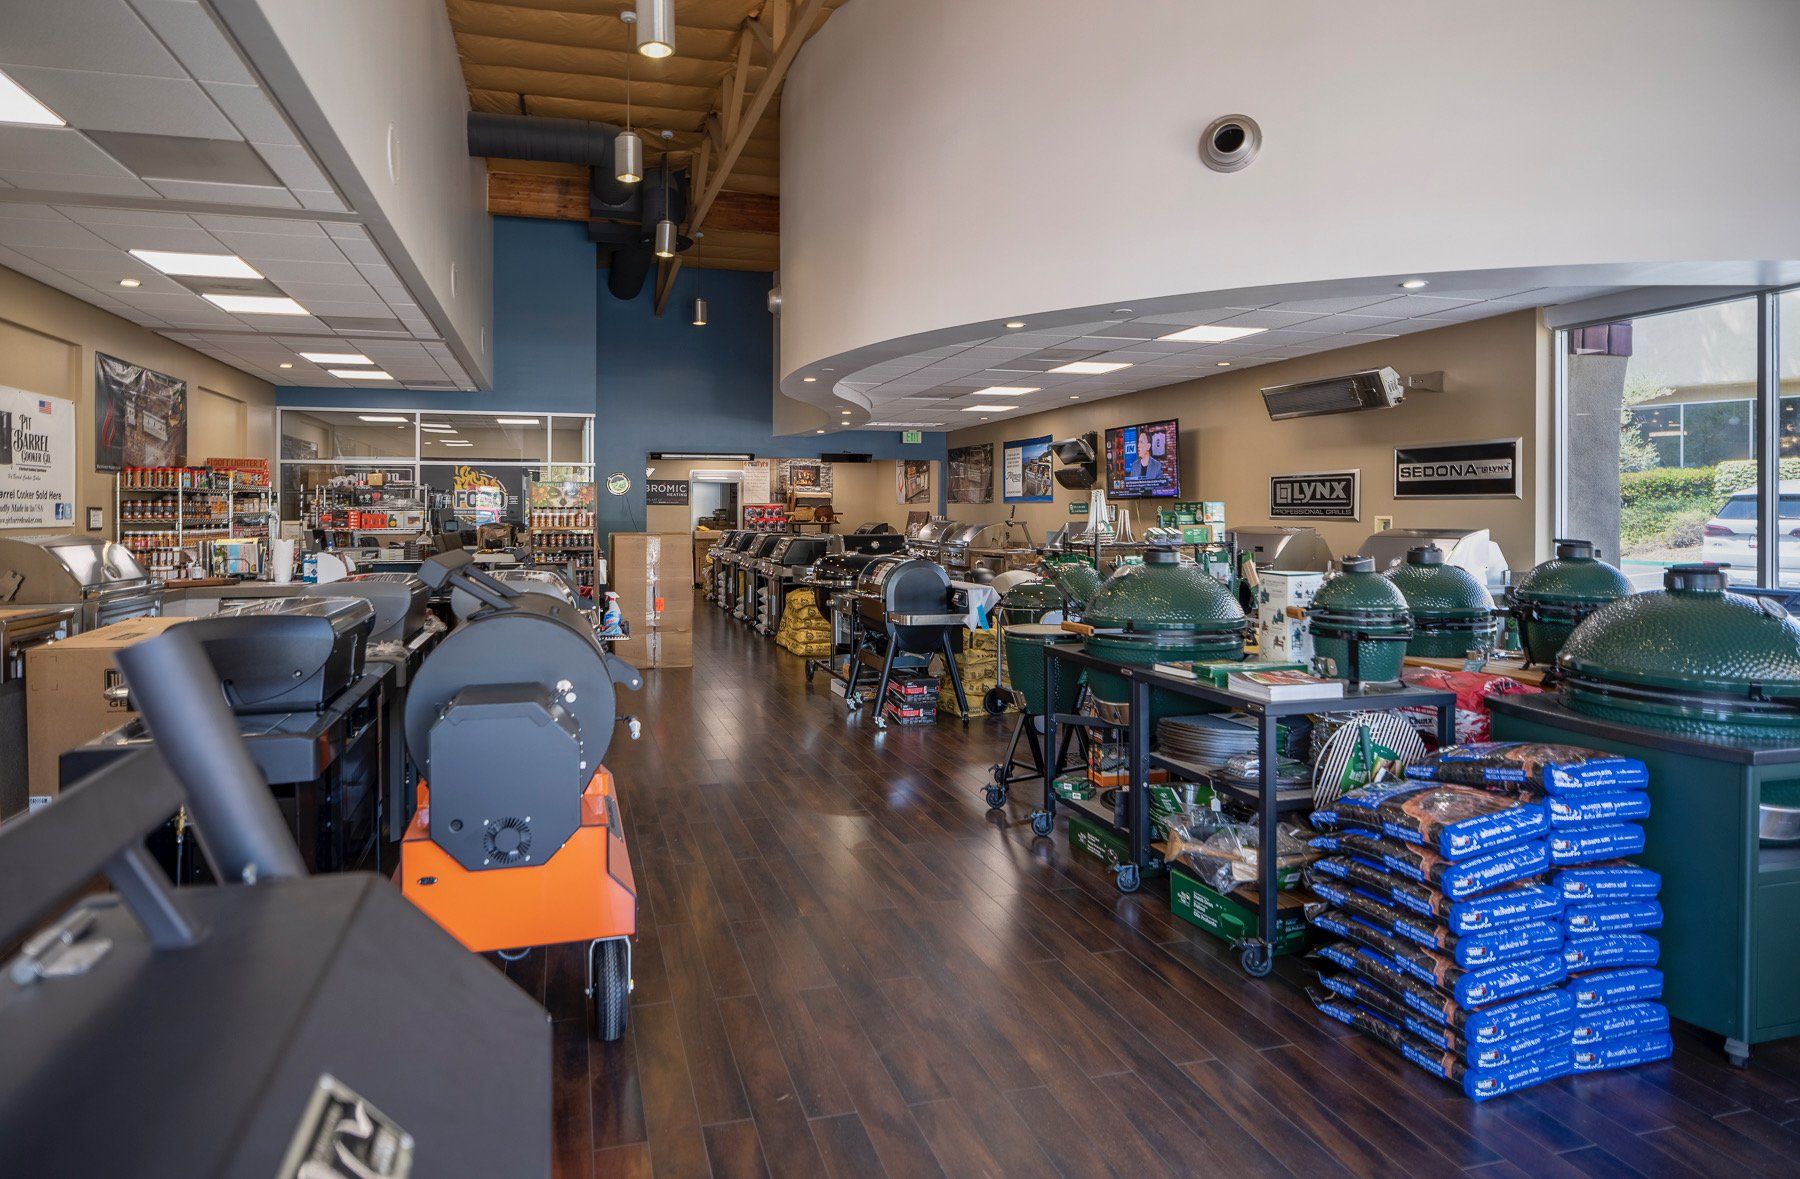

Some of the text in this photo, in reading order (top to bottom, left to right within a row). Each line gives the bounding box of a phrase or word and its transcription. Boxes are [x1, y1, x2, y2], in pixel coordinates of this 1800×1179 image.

[13, 429, 49, 452] BARREL
[906, 432, 919, 442] EXIT
[1400, 464, 1478, 478] SEDONA
[646, 484, 687, 493] BROMIC
[0, 489, 62, 501] arrel Cooker Sold Here
